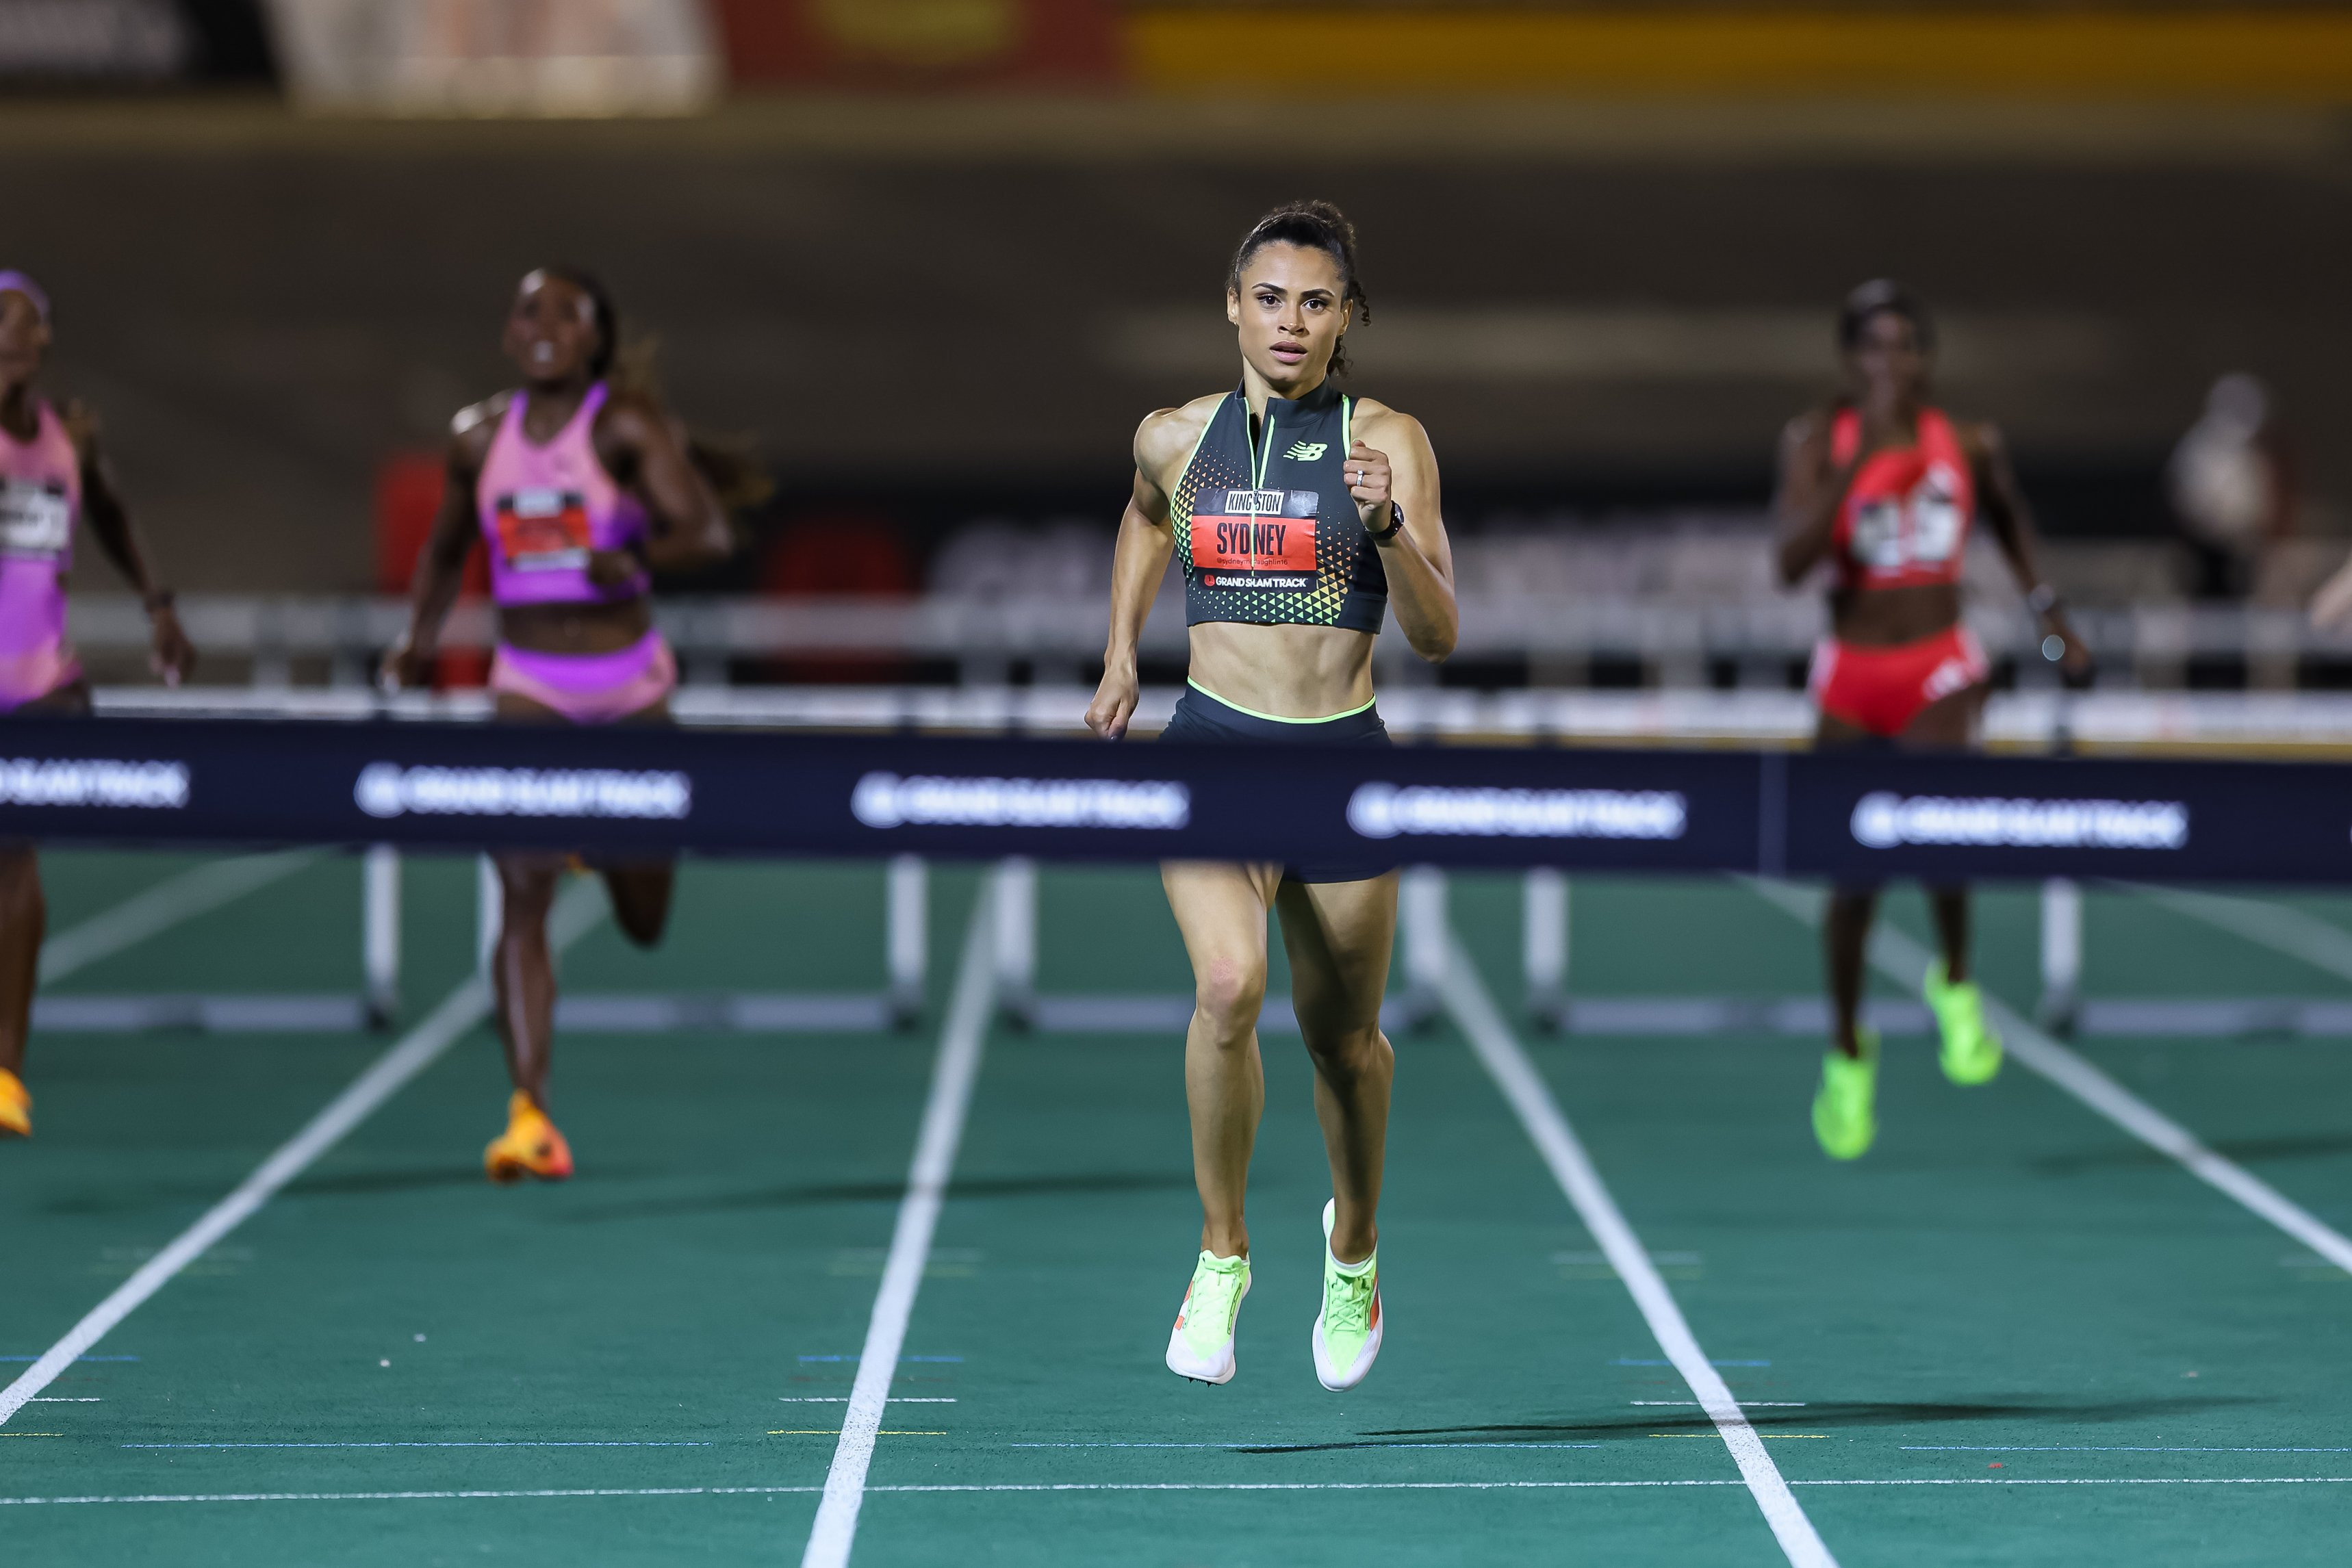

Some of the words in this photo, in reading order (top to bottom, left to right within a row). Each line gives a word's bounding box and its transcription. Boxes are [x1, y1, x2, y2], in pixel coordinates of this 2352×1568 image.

[1228, 493, 1281, 512] KINGSTON
[1216, 522, 1287, 556] SYDNEY
[1216, 576, 1245, 587] GRAND
[1245, 578, 1273, 588] SLAM
[1272, 578, 1307, 588] TRACK
